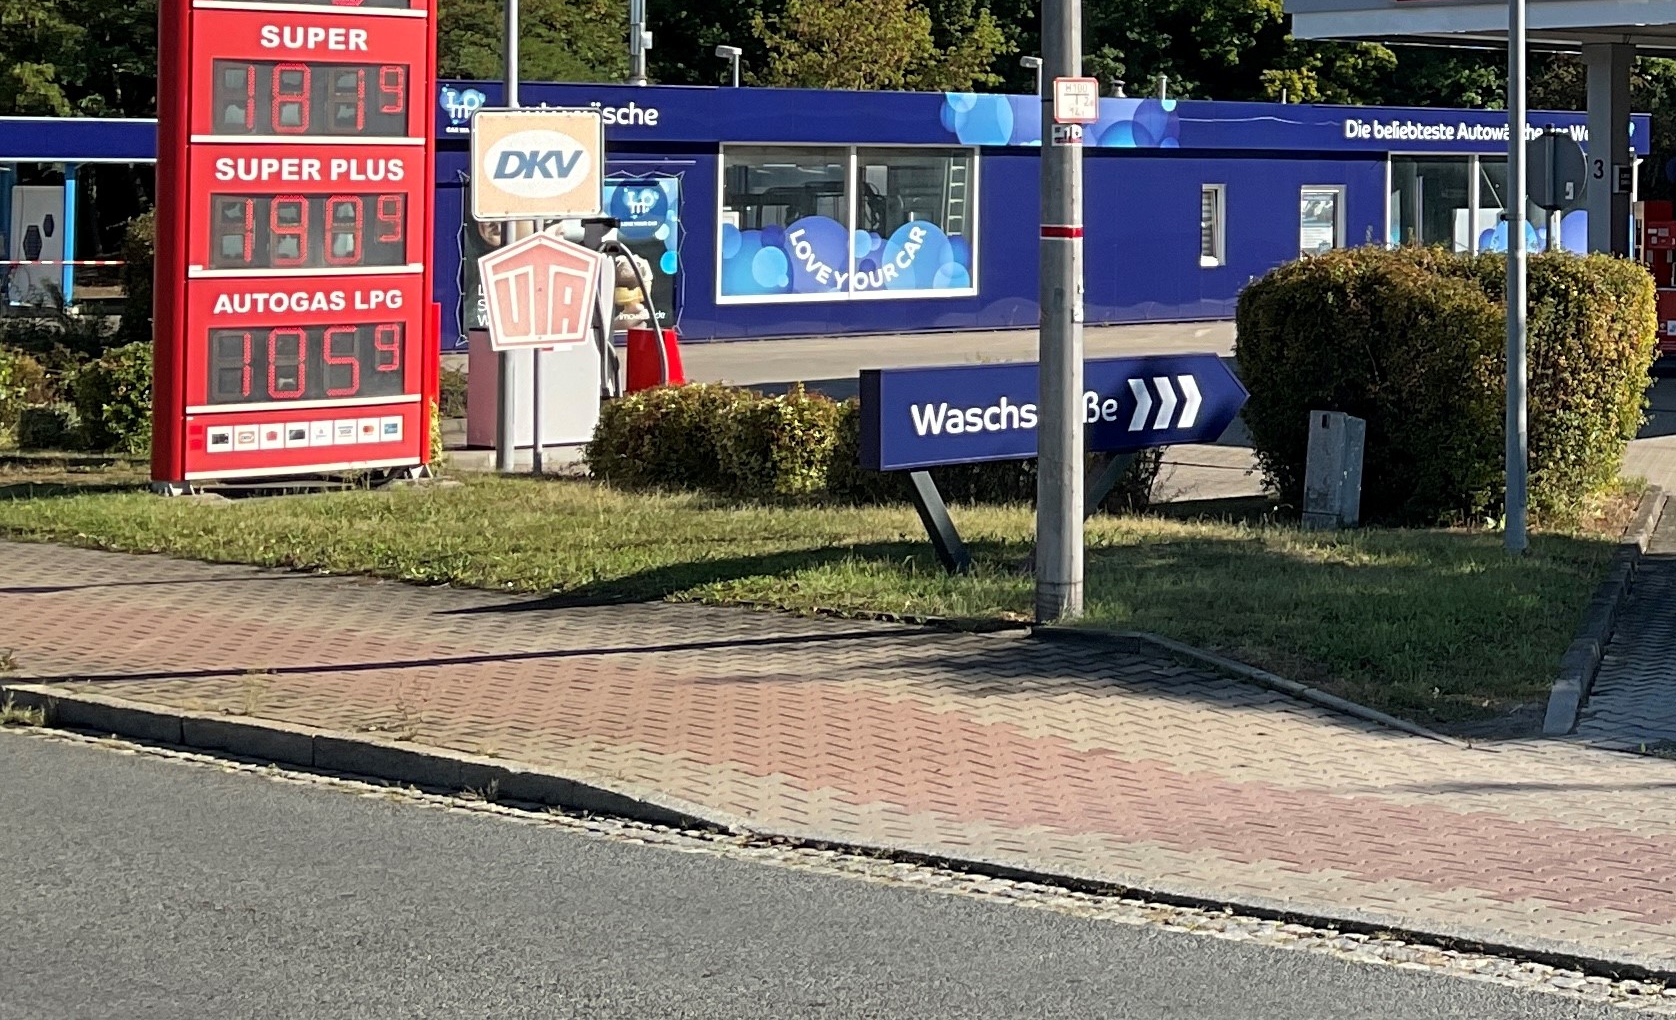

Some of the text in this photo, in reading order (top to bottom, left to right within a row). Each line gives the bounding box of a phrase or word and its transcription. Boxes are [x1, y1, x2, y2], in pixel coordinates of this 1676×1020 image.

[259, 25, 369, 52] SUPER
[1345, 119, 1372, 139] Die
[1373, 119, 1455, 140] beliebteste
[214, 157, 406, 182] SUPER PLUS
[493, 149, 584, 180] DKV
[1593, 159, 1604, 180] 3
[789, 226, 927, 290] LOVE YOUR CAR
[491, 239, 591, 337] UTA
[213, 290, 404, 315] AUTOGAS LPG
[910, 390, 1119, 436] Waschsße
